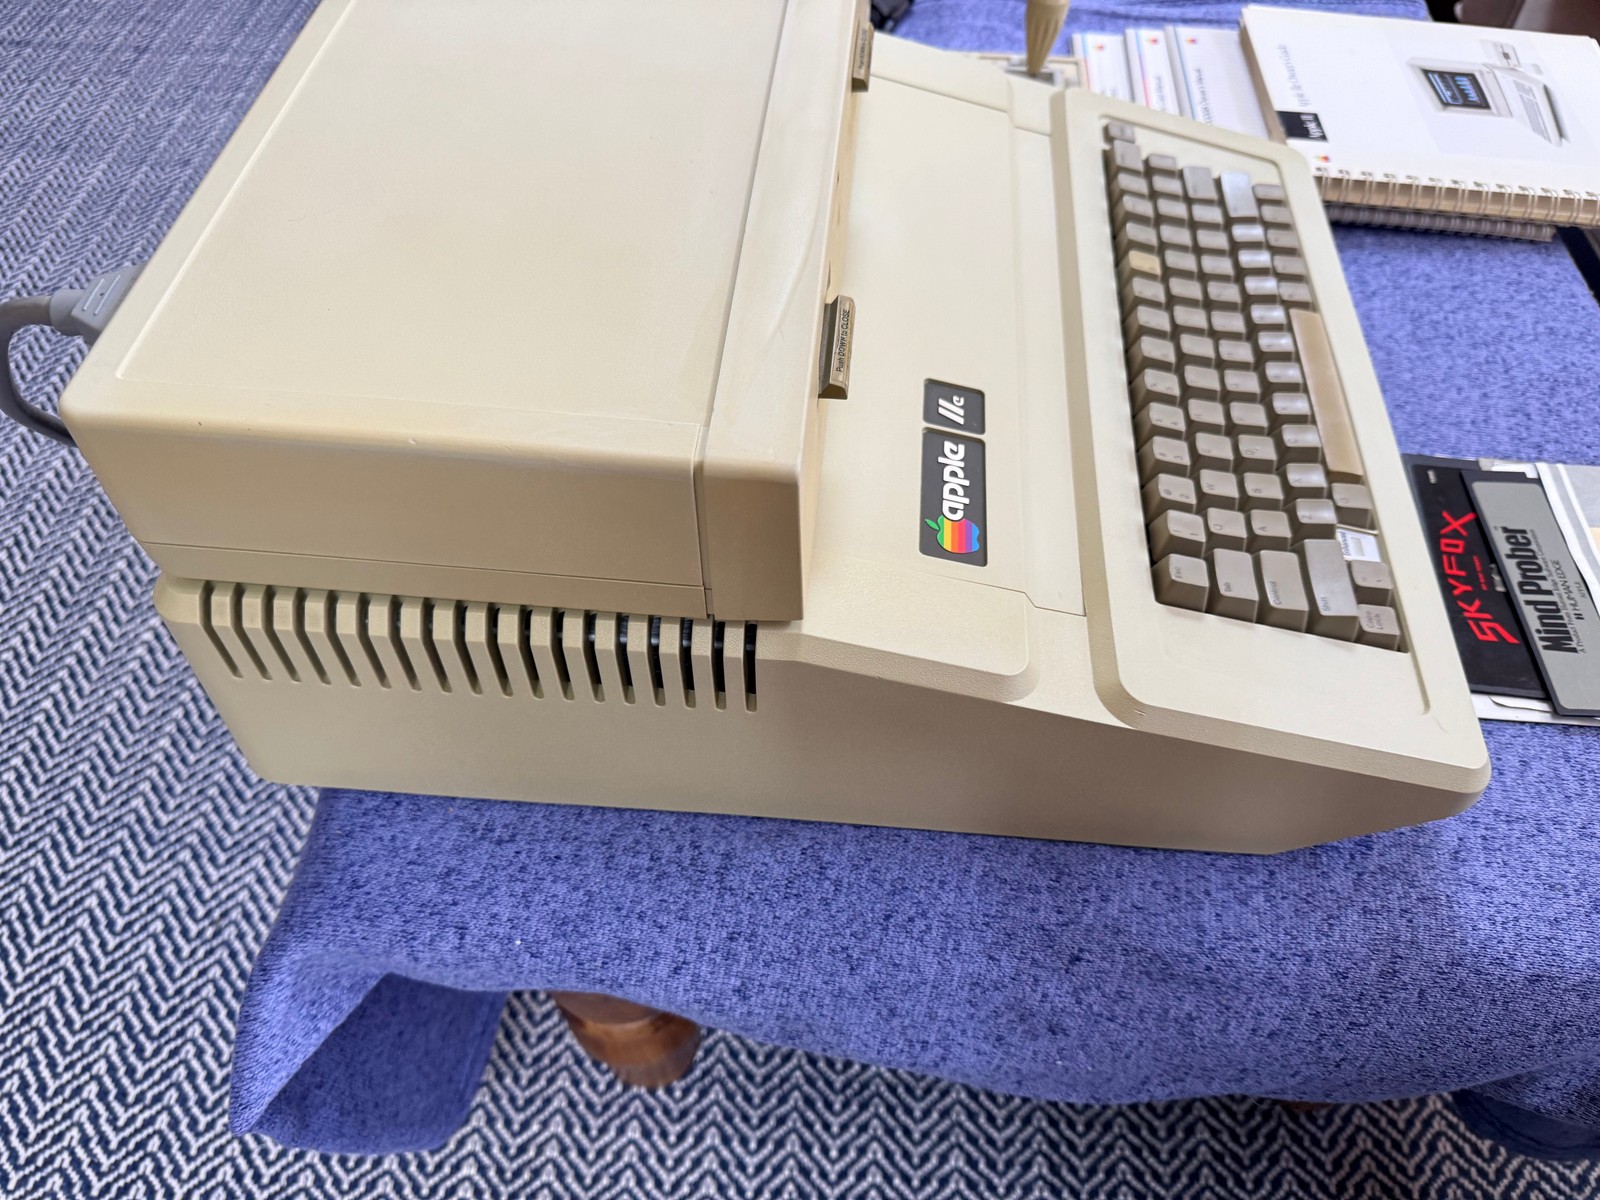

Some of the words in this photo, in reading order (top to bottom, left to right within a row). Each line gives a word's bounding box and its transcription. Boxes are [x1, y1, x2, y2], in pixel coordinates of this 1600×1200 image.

[841, 308, 850, 330] CLOSE
[837, 337, 847, 357] DOWN
[836, 357, 845, 373] Push
[938, 440, 970, 521] apple
[1502, 526, 1554, 596] Prober
[1550, 559, 1567, 580] EDGE
[1173, 565, 1183, 579] Esc
[1440, 511, 1520, 644] SKYFOX
[1223, 581, 1232, 593] Tab
[1269, 580, 1282, 605] Control
[1559, 579, 1581, 612] HUMAN
[1321, 596, 1331, 612] Shift
[1374, 612, 1384, 630] Lock
[1523, 599, 1580, 654] Mind
